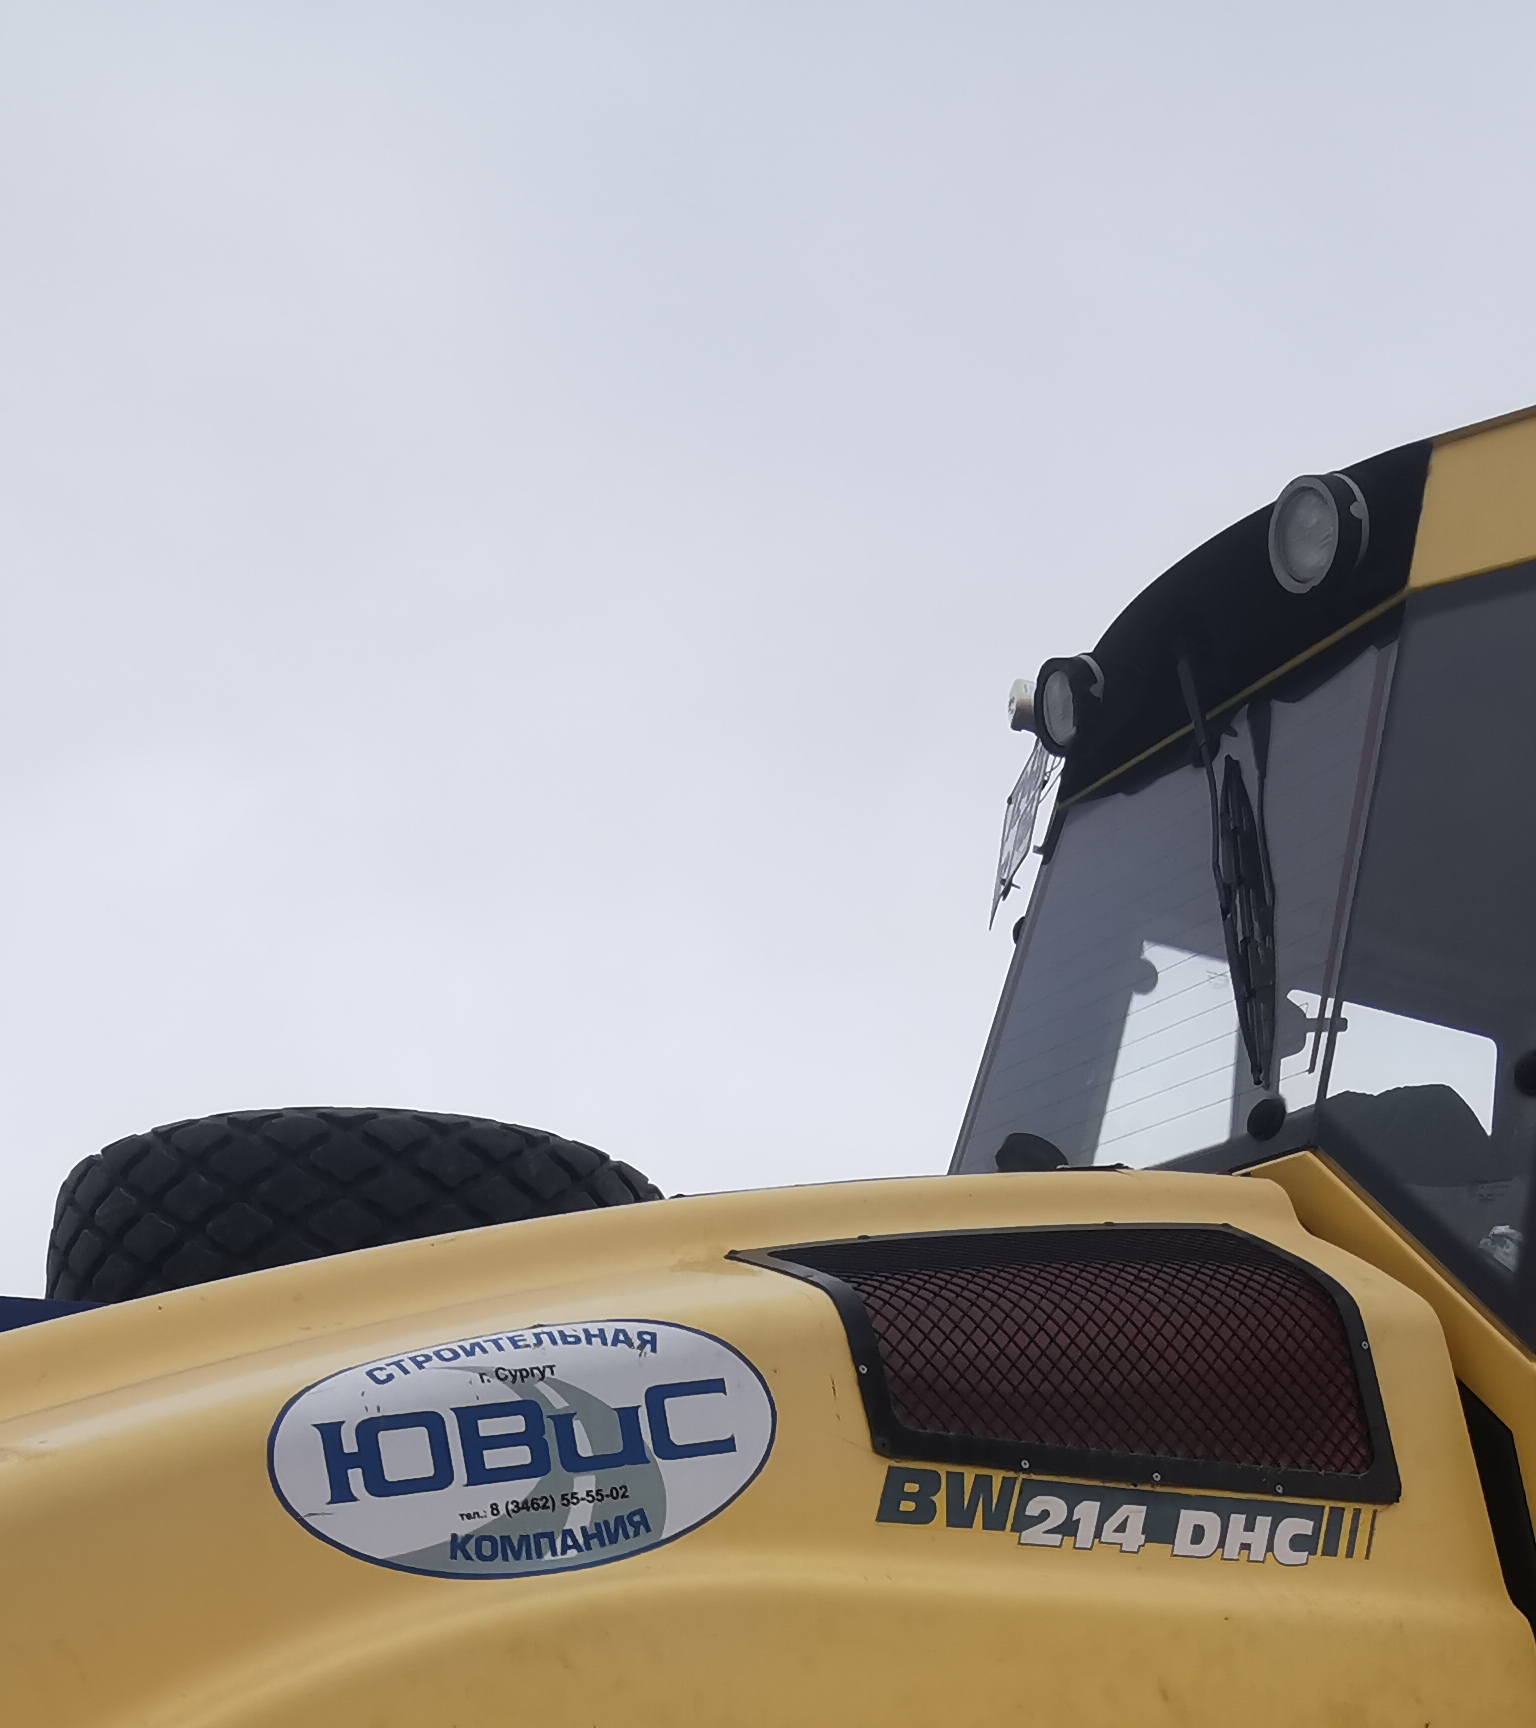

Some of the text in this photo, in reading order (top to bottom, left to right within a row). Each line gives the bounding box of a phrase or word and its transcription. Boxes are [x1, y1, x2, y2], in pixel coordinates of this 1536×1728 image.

[365, 1326, 658, 1386] СТРОИТЕЛЬНАЯ
[494, 1363, 556, 1385] Сургут
[490, 1502, 501, 1517] 8
[505, 1494, 556, 1518] (3462)
[560, 1484, 630, 1508] 55-55-02
[449, 1507, 652, 1563] КОМПАНИЯ
[1172, 1508, 1315, 1567] DHC
